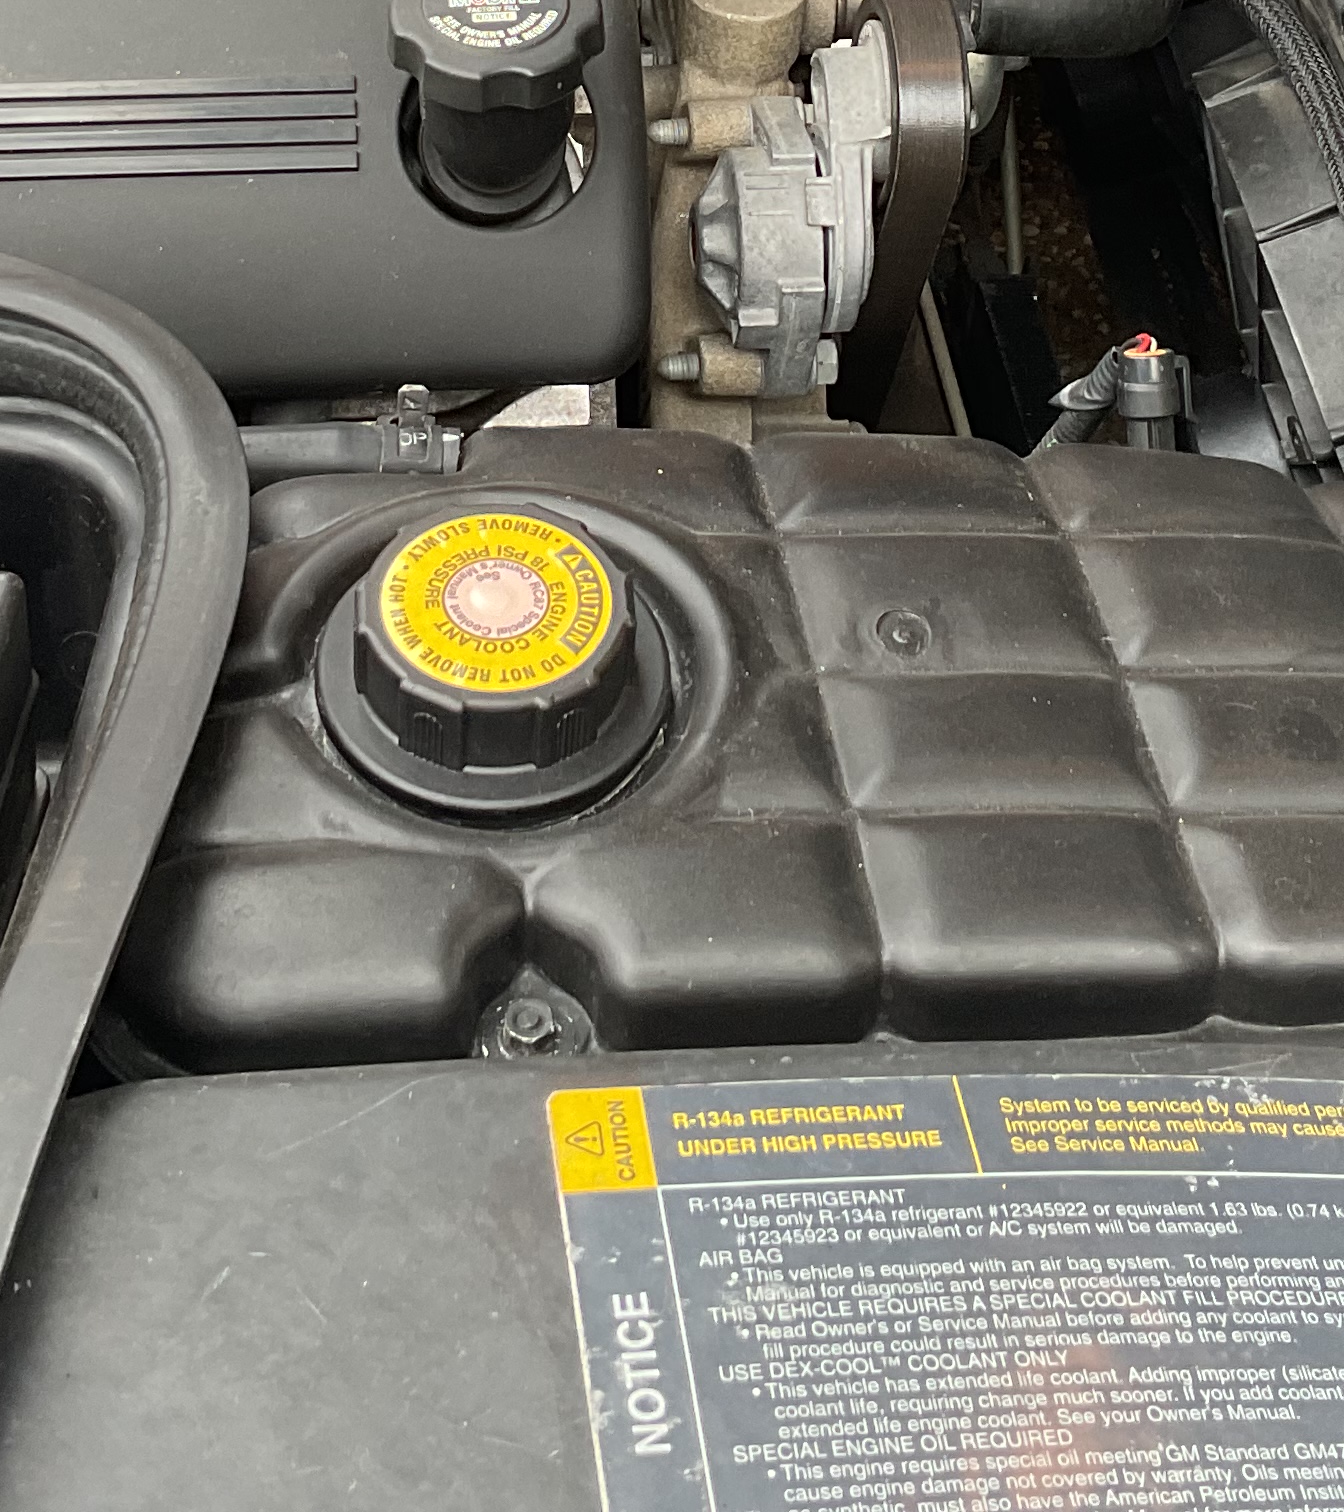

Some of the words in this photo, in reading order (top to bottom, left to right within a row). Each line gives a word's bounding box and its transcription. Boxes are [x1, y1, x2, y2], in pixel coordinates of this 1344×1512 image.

[429, 15, 461, 42] SPECIAL
[462, 36, 501, 47] ENGINE
[504, 35, 523, 47] OIL
[521, 10, 559, 41] REQUIRED
[442, 15, 461, 29] SEE
[459, 25, 506, 39] OWNER'S
[507, 12, 542, 36] MANUAL
[475, 12, 512, 21] NOTICE
[407, 521, 471, 563] SLOWLY
[479, 519, 555, 542] REMOVE
[496, 545, 530, 565] PSI
[531, 555, 551, 572] 18
[424, 545, 491, 611] PRESSURE
[446, 569, 479, 600] Manual
[475, 569, 502, 582] See
[479, 561, 532, 581] Owner's
[389, 573, 407, 605] HOT
[533, 581, 568, 643] ENGINE
[574, 569, 601, 646] CAUTION
[391, 607, 425, 652] WHEN
[434, 619, 531, 655] COOLANT
[497, 610, 538, 638] Special
[420, 650, 493, 683] REMOVE
[498, 666, 537, 684] NOT
[540, 654, 567, 674] DO
[672, 1110, 745, 1130] R-134a
[751, 1104, 905, 1127] REFRIGERANT
[999, 1097, 1070, 1118] System
[1075, 1098, 1092, 1113] to
[1098, 1098, 1121, 1114] be
[1127, 1098, 1204, 1114] serviced
[1208, 1098, 1230, 1117] by
[1235, 1100, 1310, 1119] qualified
[609, 1100, 637, 1182] CAUTION
[1005, 1117, 1089, 1135] Improper
[1095, 1117, 1161, 1133] service
[1166, 1118, 1246, 1134] methods
[1250, 1121, 1288, 1138] may
[1293, 1122, 1344, 1138] cause
[678, 1137, 756, 1158] UNDER
[762, 1134, 817, 1155] HIGH
[823, 1130, 942, 1151] PRESSURE
[1011, 1136, 1049, 1153] See
[1054, 1136, 1124, 1153] Service
[1130, 1136, 1205, 1153] Manual.
[688, 1196, 756, 1214] R-134a
[761, 1189, 905, 1210] REFRIGERANT
[699, 1251, 733, 1267] AIR
[739, 1249, 784, 1265] BAG
[707, 1306, 757, 1324] THIS
[761, 1301, 854, 1320] VEHICLE
[859, 1296, 967, 1315] REQUIRES
[972, 1295, 986, 1310] A
[990, 1292, 1076, 1310] SPECIAL
[1081, 1290, 1176, 1308] COOLANT
[1183, 1290, 1224, 1306] FILL
[612, 1291, 672, 1455] NOTICE
[718, 1364, 763, 1381] USE
[769, 1356, 901, 1379] DEX-COOL™
[907, 1351, 1007, 1372] COOLANT
[1014, 1350, 1068, 1368] ONLY
[778, 1420, 868, 1439] extended
[873, 1418, 903, 1434] life
[907, 1417, 971, 1436] engine
[977, 1413, 1051, 1430] coolant.
[1058, 1409, 1098, 1426] See
[1100, 1408, 1140, 1425] your
[1146, 1404, 1223, 1423] Owner's
[1227, 1403, 1302, 1422] Manual.
[733, 1444, 827, 1463] SPECIAL
[832, 1439, 915, 1458] ENGINE
[920, 1434, 956, 1452] OIL
[961, 1428, 1074, 1450] REQUIRED
